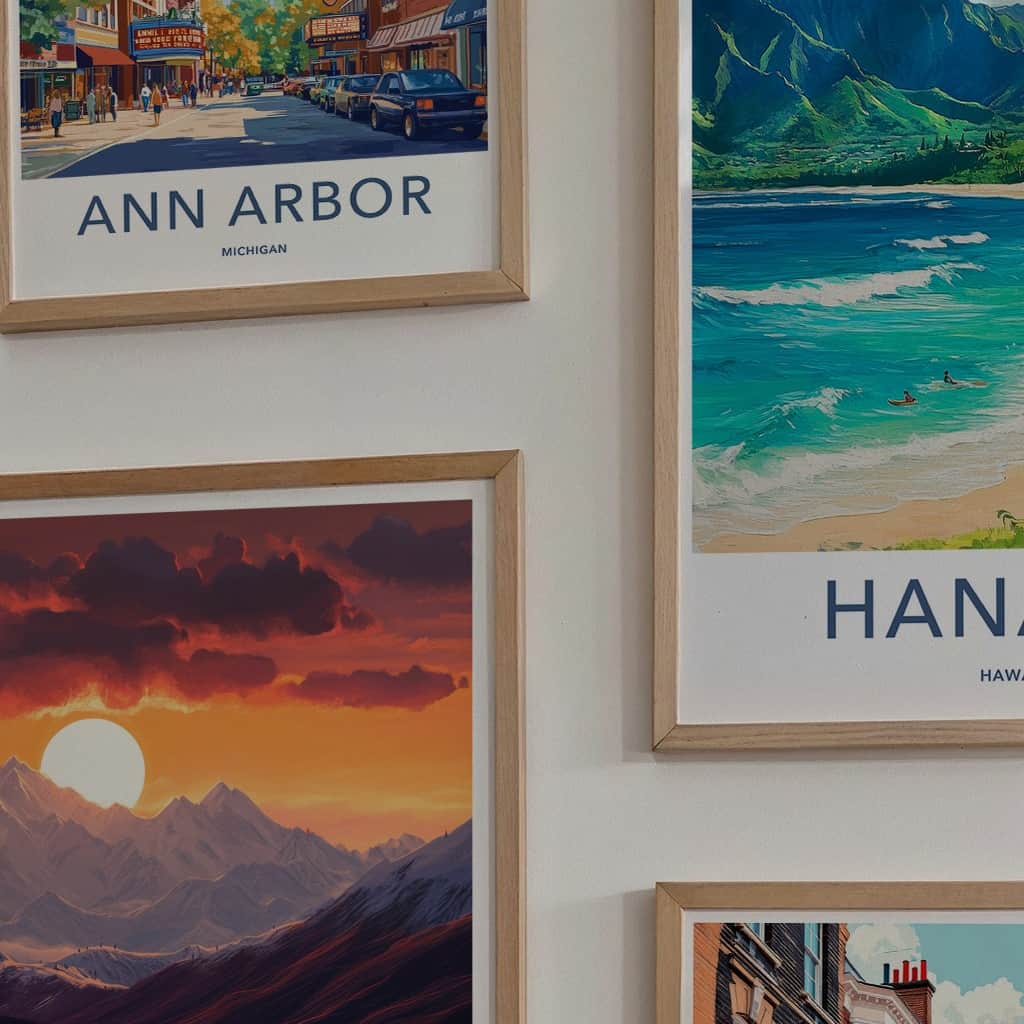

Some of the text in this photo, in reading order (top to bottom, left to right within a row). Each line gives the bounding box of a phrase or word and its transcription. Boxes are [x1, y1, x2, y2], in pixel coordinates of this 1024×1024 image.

[77, 175, 432, 236] ANN ARBOR
[221, 244, 288, 257] MICHIGAN
[827, 577, 1024, 640] HAN
[980, 668, 1024, 682] HAW
